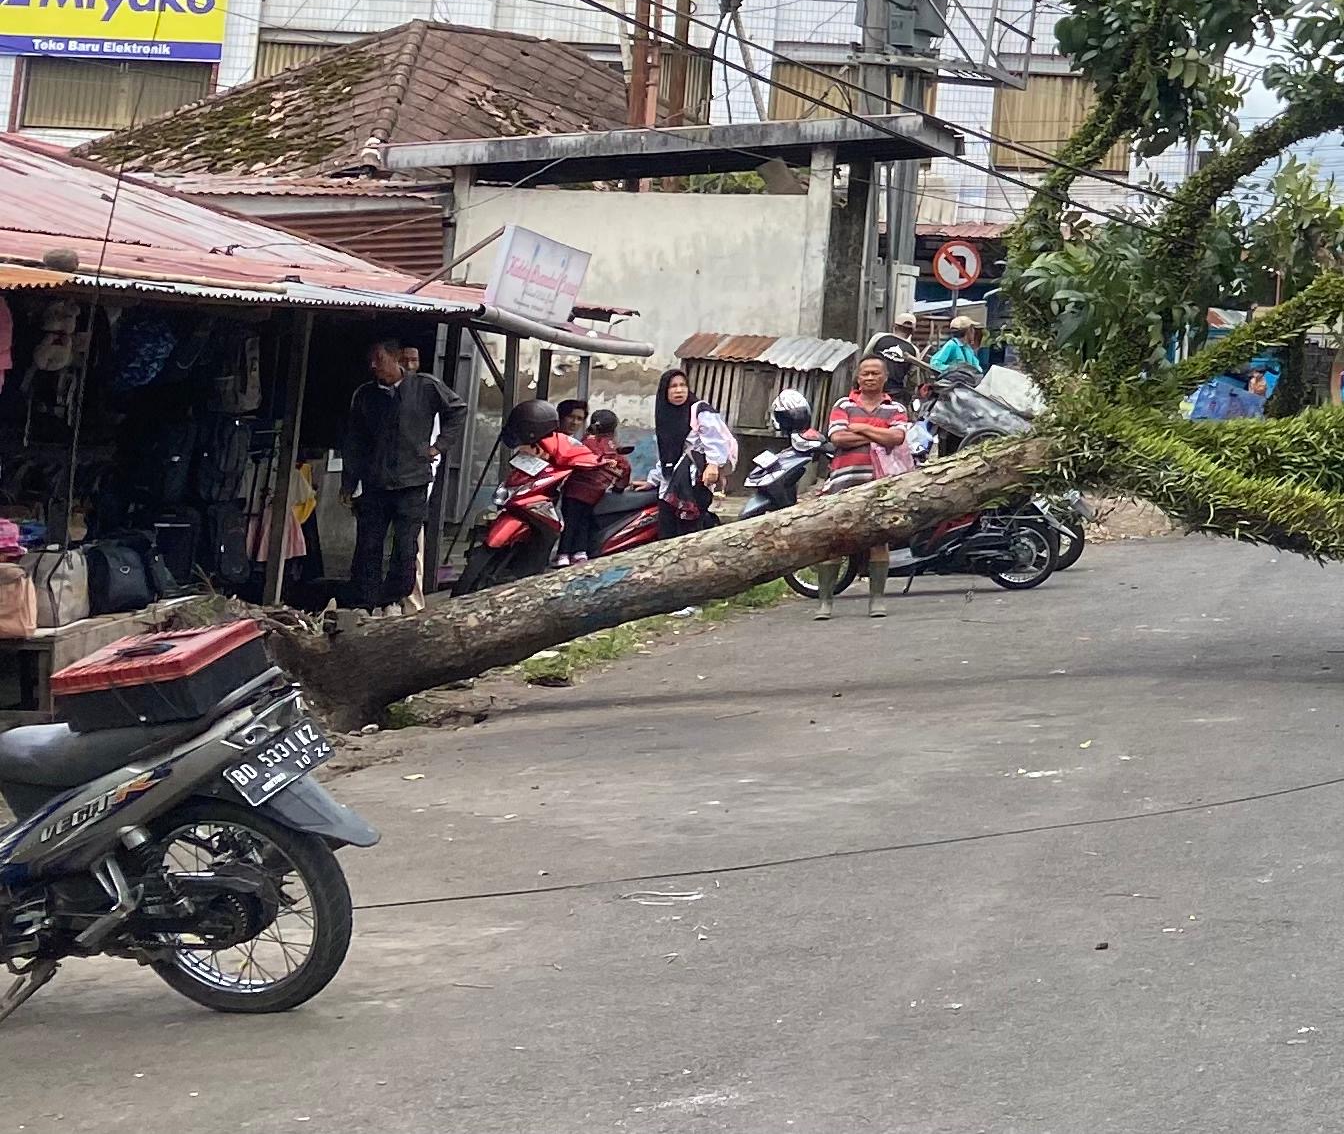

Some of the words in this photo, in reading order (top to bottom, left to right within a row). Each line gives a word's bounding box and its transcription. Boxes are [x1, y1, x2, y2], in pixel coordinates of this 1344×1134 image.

[32, 38, 65, 51] Toko
[68, 41, 100, 53] Baru
[103, 41, 171, 55] Elektronik
[230, 763, 258, 786] BD
[257, 737, 299, 768] 5331
[294, 724, 319, 746] KZ
